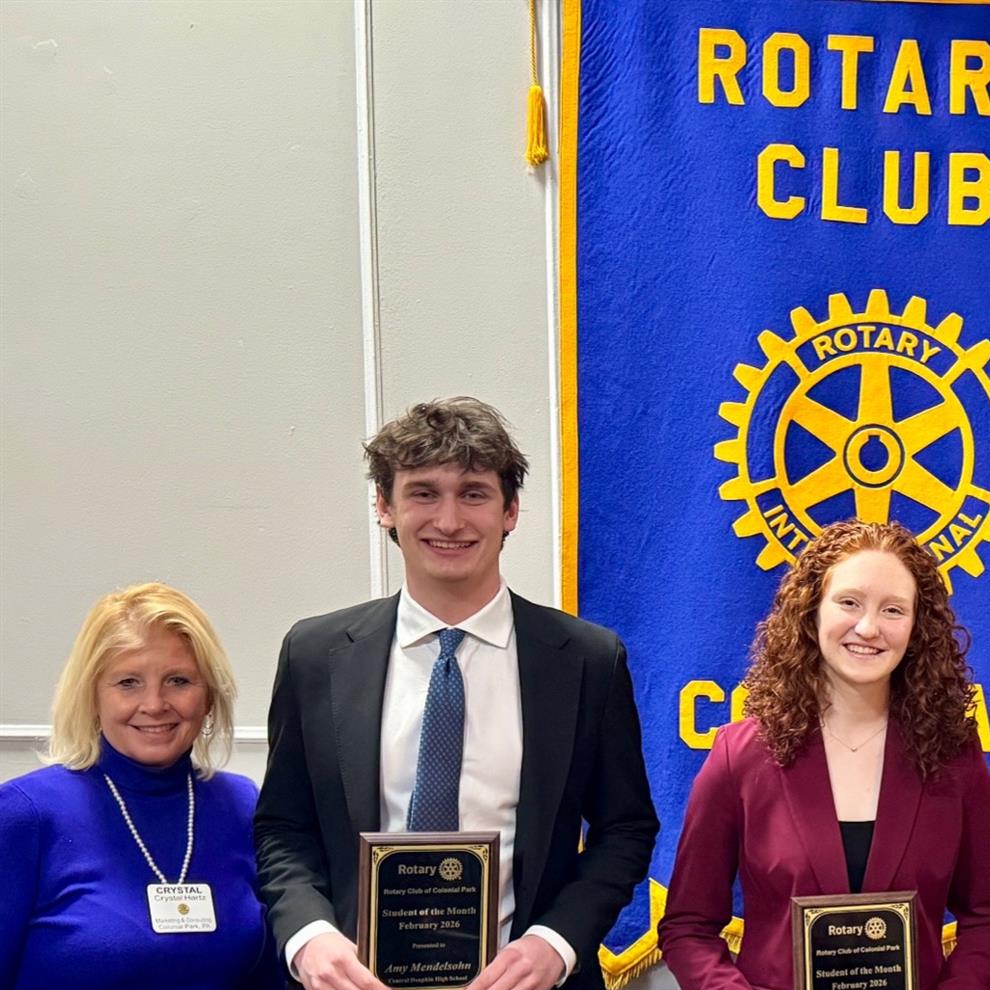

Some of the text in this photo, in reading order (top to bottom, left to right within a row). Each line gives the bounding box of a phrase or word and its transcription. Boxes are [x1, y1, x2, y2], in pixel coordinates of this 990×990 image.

[811, 324, 940, 365] ROTARY
[398, 864, 437, 876] Rotary
[156, 886, 203, 895] CRYSTAL
[154, 895, 183, 903] Crystal
[382, 906, 476, 917] Student of the Month
[399, 920, 460, 931] February 2026
[828, 925, 863, 936] Rotary
[816, 949, 836, 957] Rotary
[860, 945, 885, 953] Colonial
[384, 963, 408, 975] Amy
[816, 964, 902, 978] Student of the Month
[832, 978, 888, 990] February 2026
